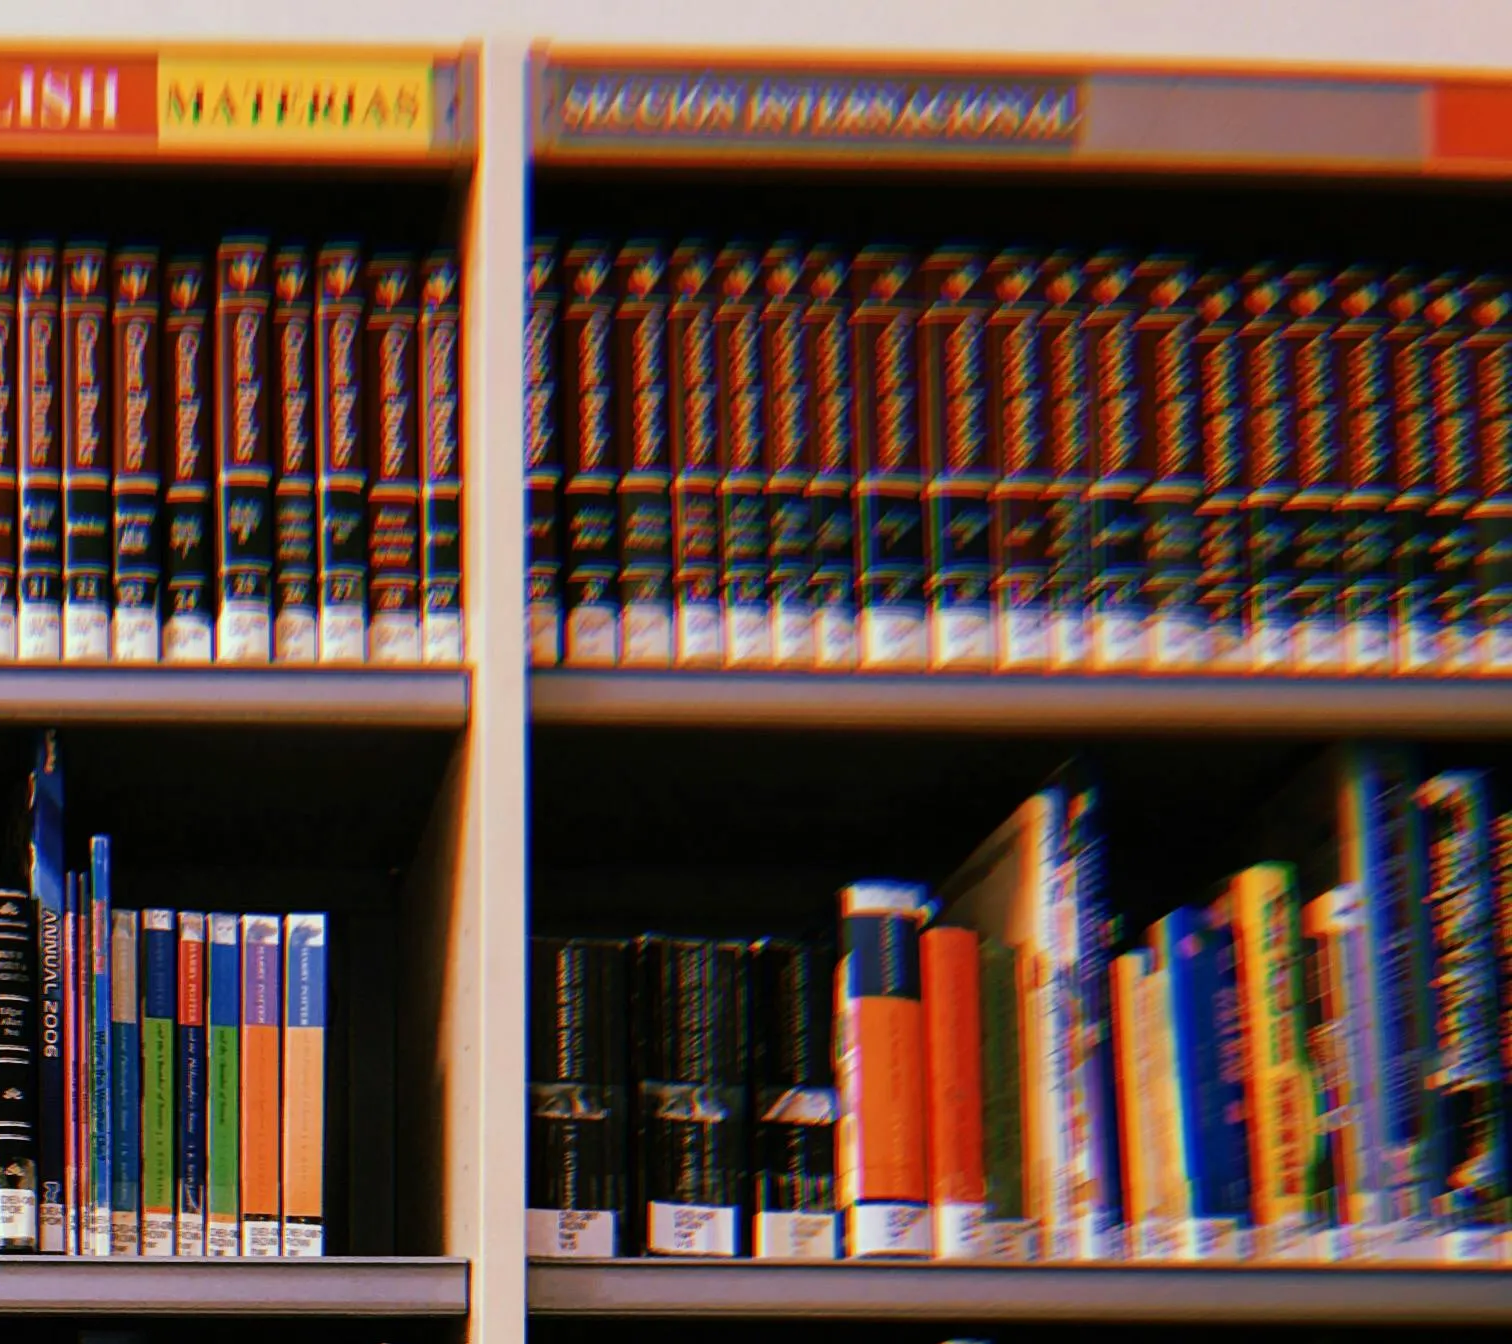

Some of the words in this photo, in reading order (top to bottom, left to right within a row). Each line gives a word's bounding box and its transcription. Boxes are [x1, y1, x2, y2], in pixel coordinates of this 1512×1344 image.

[166, 78, 421, 131] MATERIAS
[42, 911, 61, 994] ANNUAL
[43, 1000, 59, 1058] 2006
